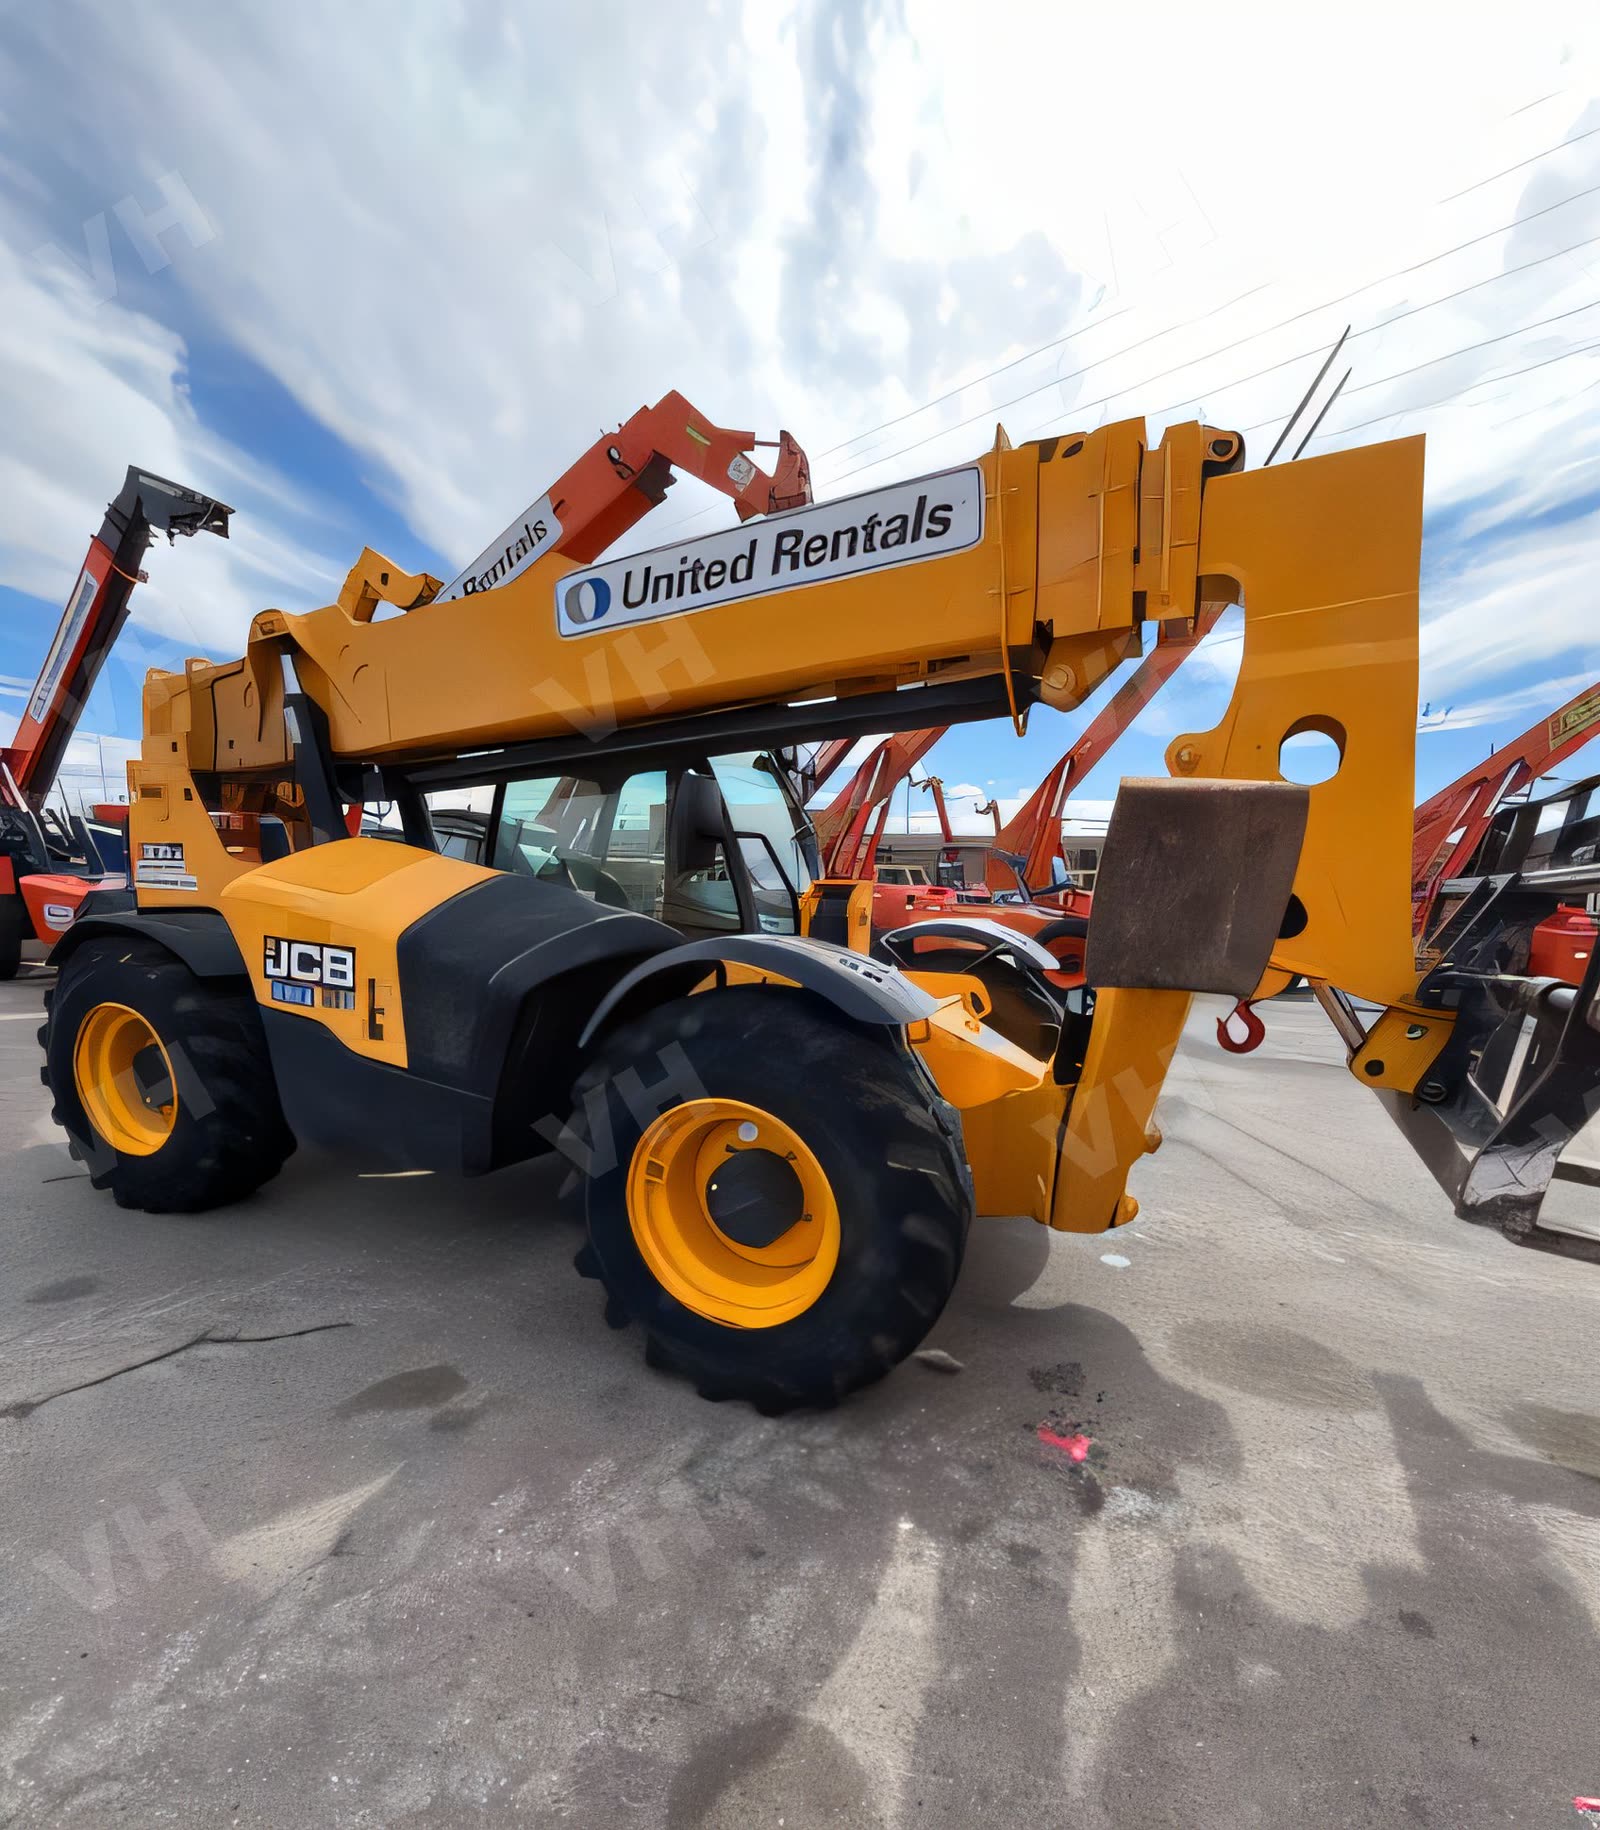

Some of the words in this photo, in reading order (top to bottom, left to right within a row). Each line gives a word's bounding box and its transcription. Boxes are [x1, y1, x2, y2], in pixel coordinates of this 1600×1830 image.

[622, 538, 758, 610] United
[771, 494, 954, 576] Rentals
[265, 938, 354, 989] JCB
